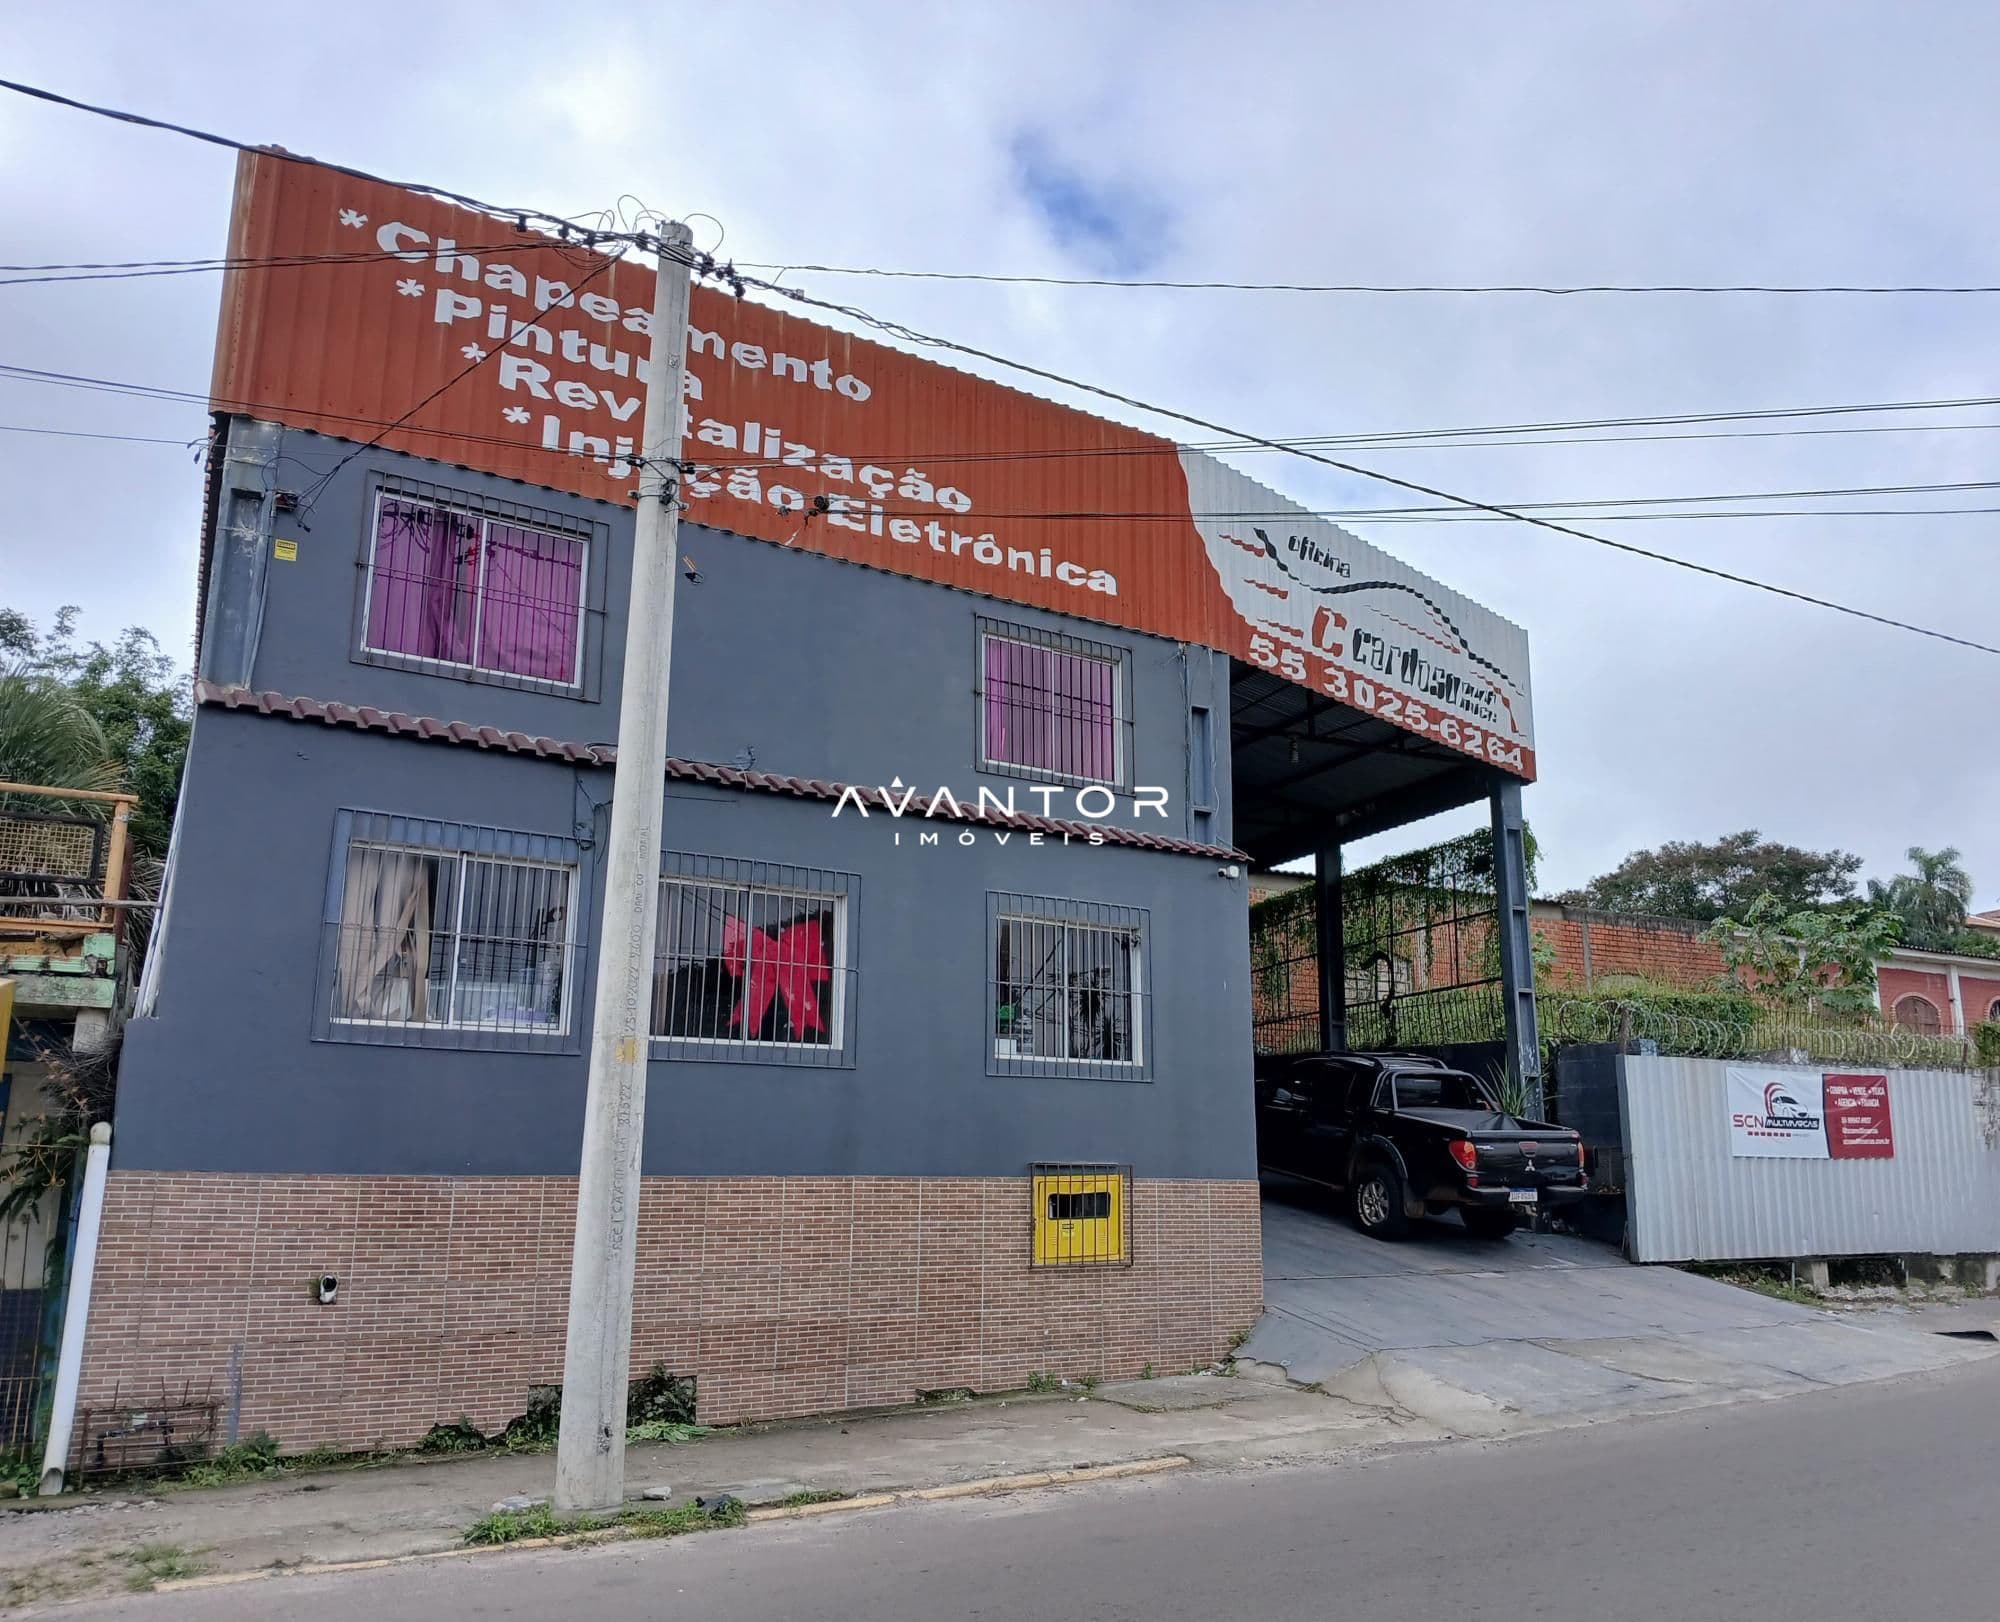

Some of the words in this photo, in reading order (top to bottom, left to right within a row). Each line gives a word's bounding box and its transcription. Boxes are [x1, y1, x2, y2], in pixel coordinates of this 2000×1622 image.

[376, 221, 872, 402] Chapeamento
[498, 351, 973, 514] Revtalização
[541, 414, 804, 511] Injção
[825, 493, 1118, 597] Eletrônica
[1249, 633, 1307, 681] 55
[1323, 665, 1524, 771] 3025-6264
[1732, 1114, 1764, 1129] SCN
